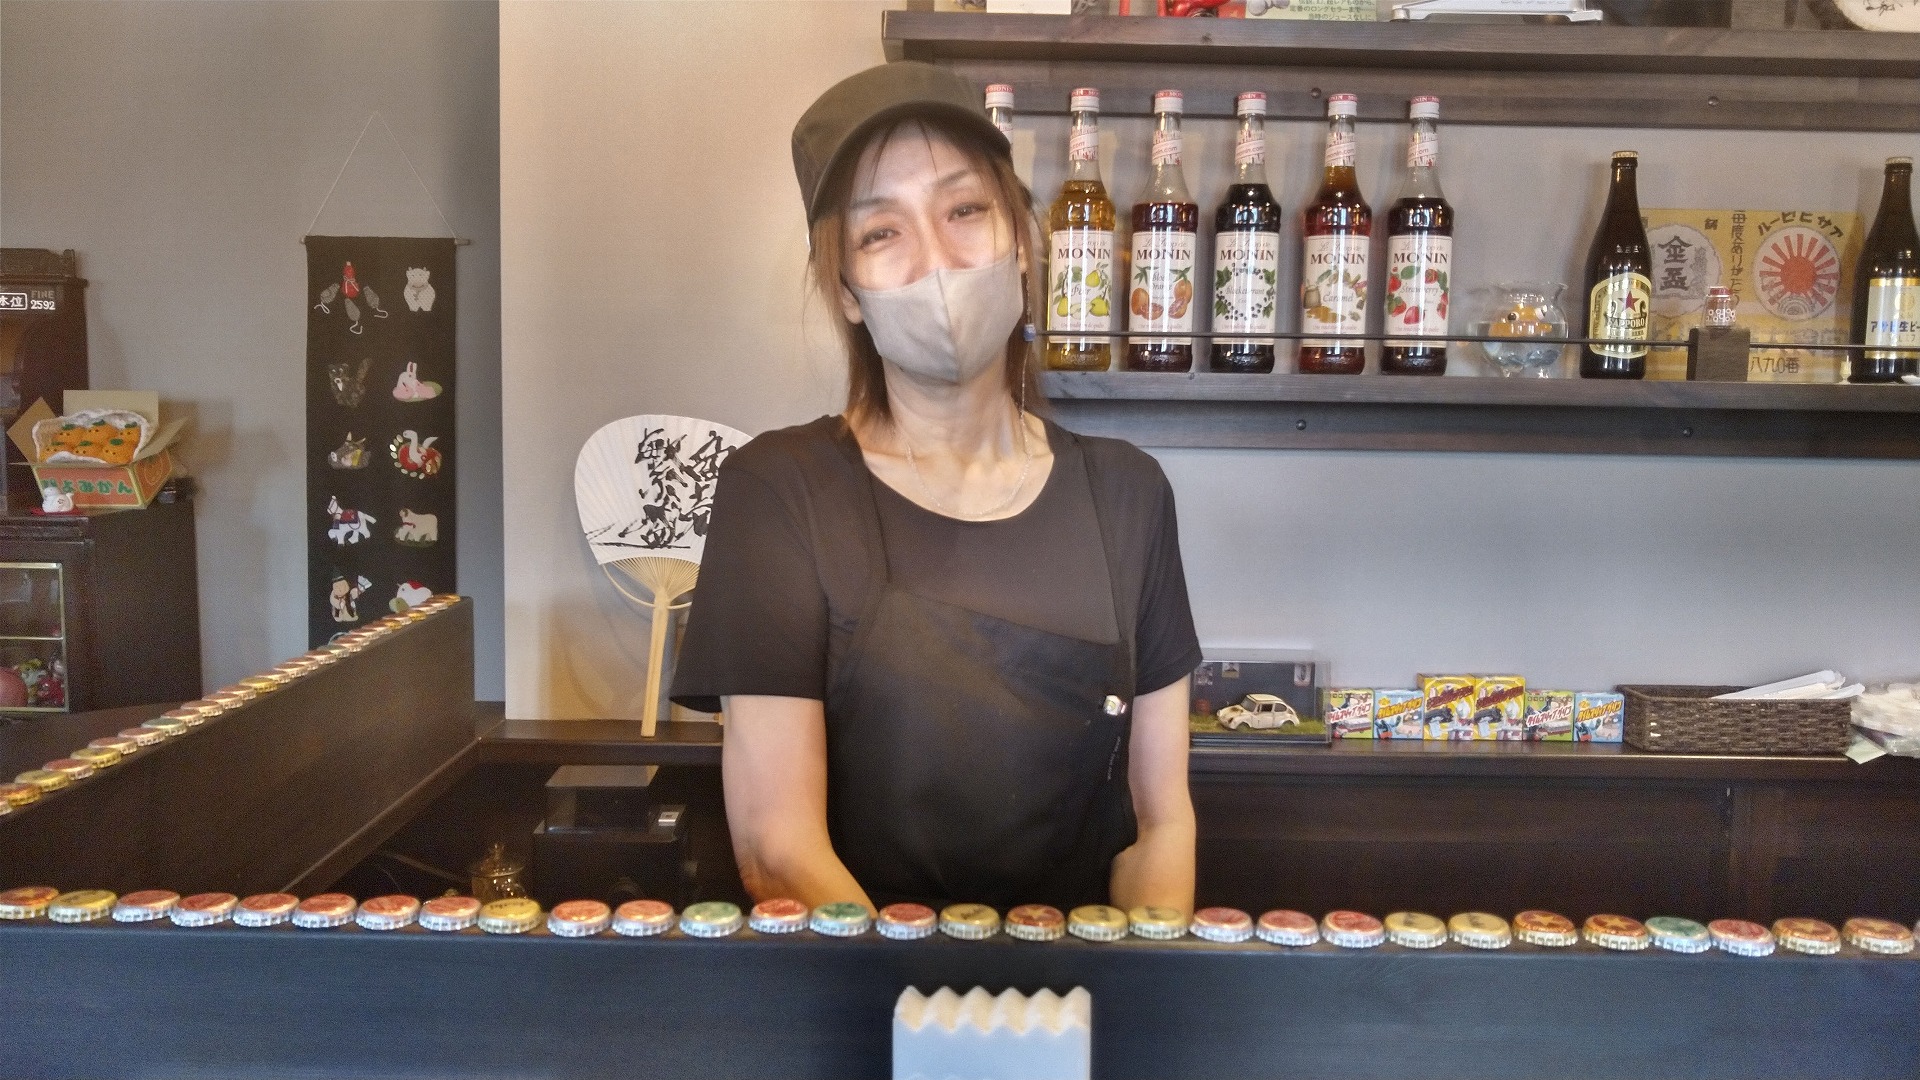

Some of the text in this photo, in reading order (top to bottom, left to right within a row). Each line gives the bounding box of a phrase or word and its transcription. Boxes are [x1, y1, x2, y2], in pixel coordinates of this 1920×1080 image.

[1058, 248, 1111, 259] MONIN
[1136, 249, 1191, 260] MONIN
[1220, 249, 1274, 260] MONIN
[1310, 253, 1365, 265] MONIN
[1393, 252, 1448, 264] MONIN
[31, 290, 55, 299] FINE
[30, 299, 56, 311] 2592
[1607, 317, 1645, 329] SAPPORO
